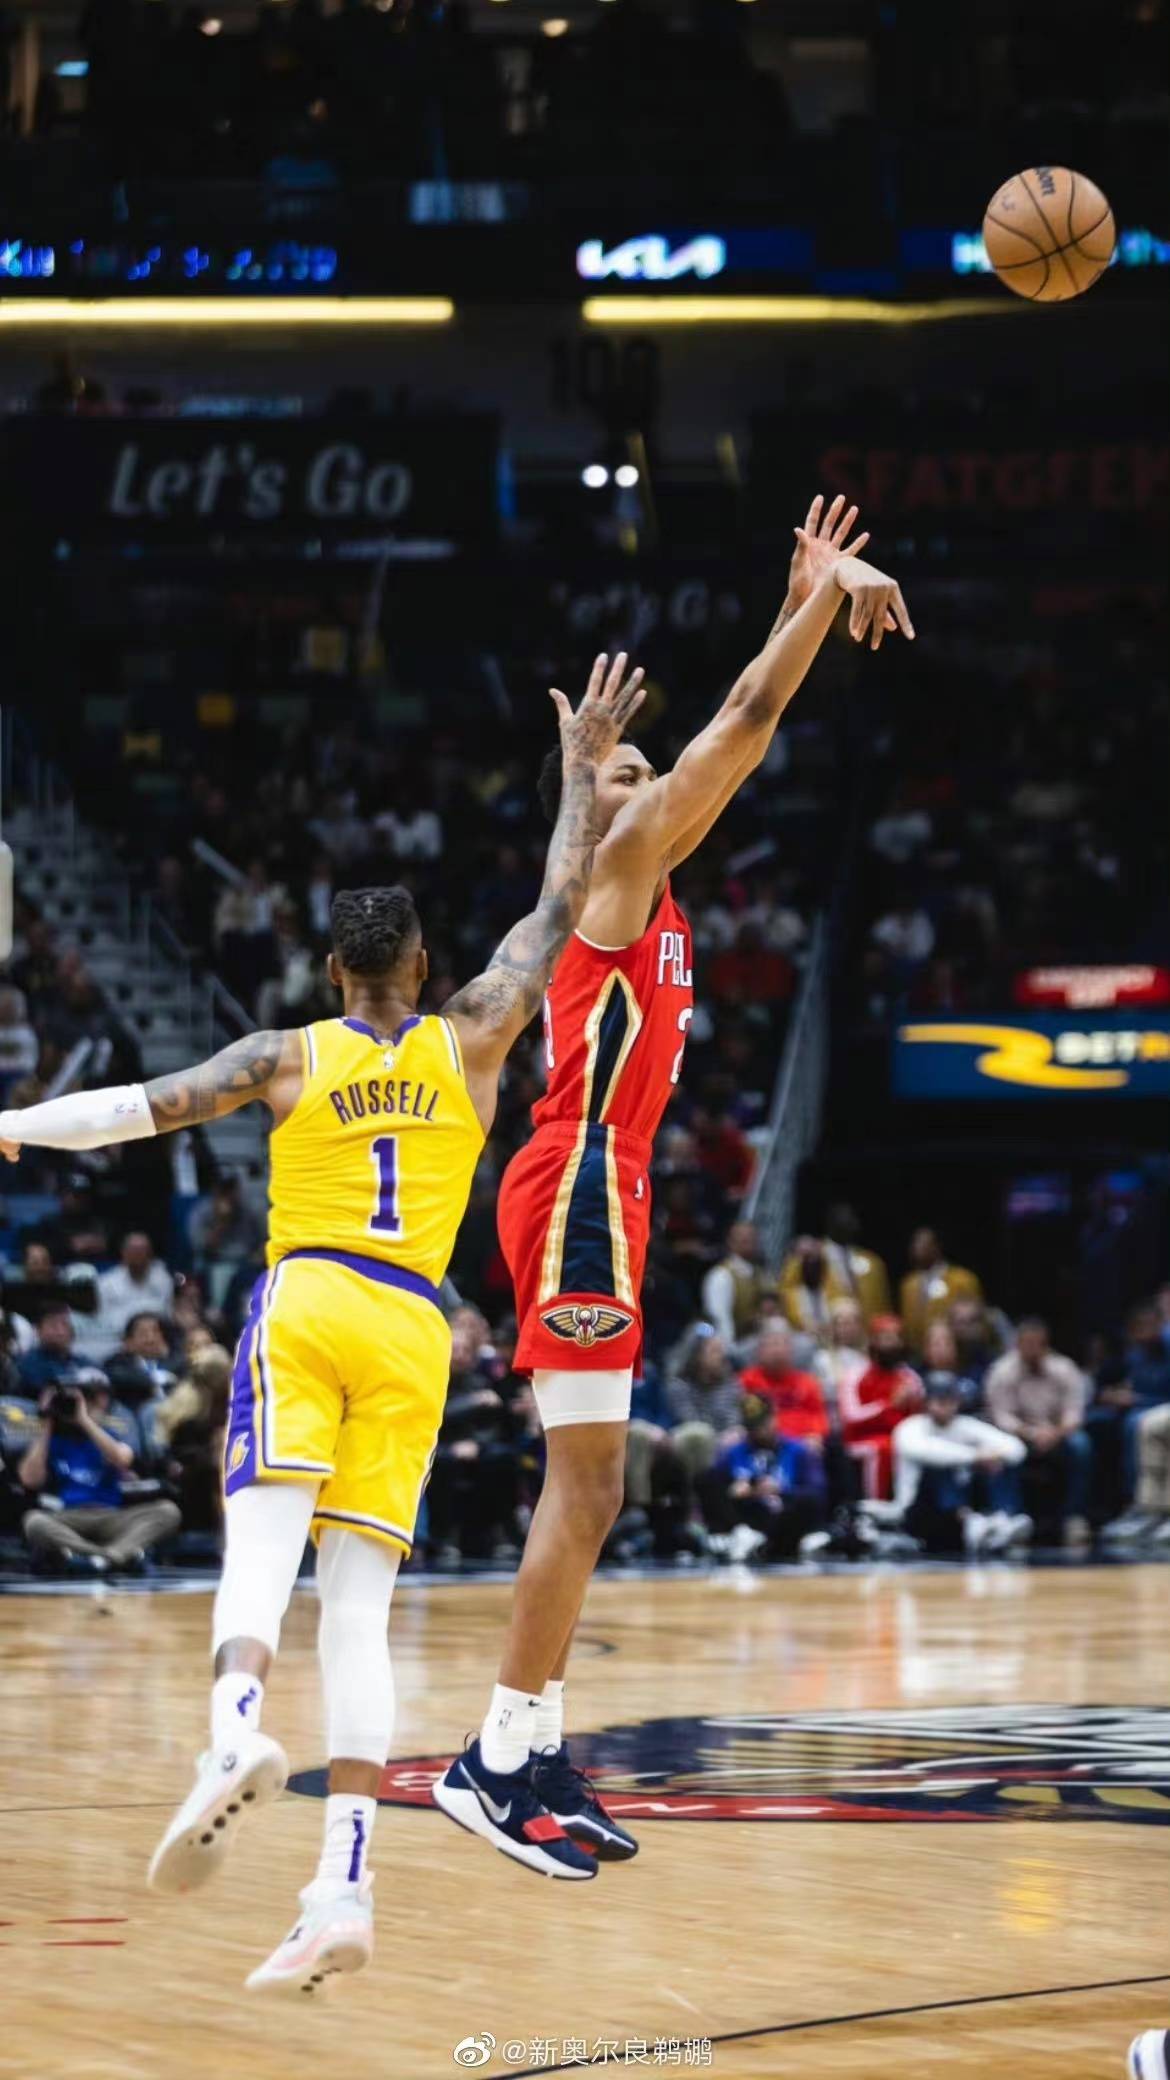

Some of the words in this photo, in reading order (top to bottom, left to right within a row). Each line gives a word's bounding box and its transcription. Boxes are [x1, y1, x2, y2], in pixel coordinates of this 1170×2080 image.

[108, 441, 287, 518] Let's
[308, 441, 413, 518] Go
[329, 1079, 440, 1125] RUSSELL
[369, 1135, 404, 1240] 1
